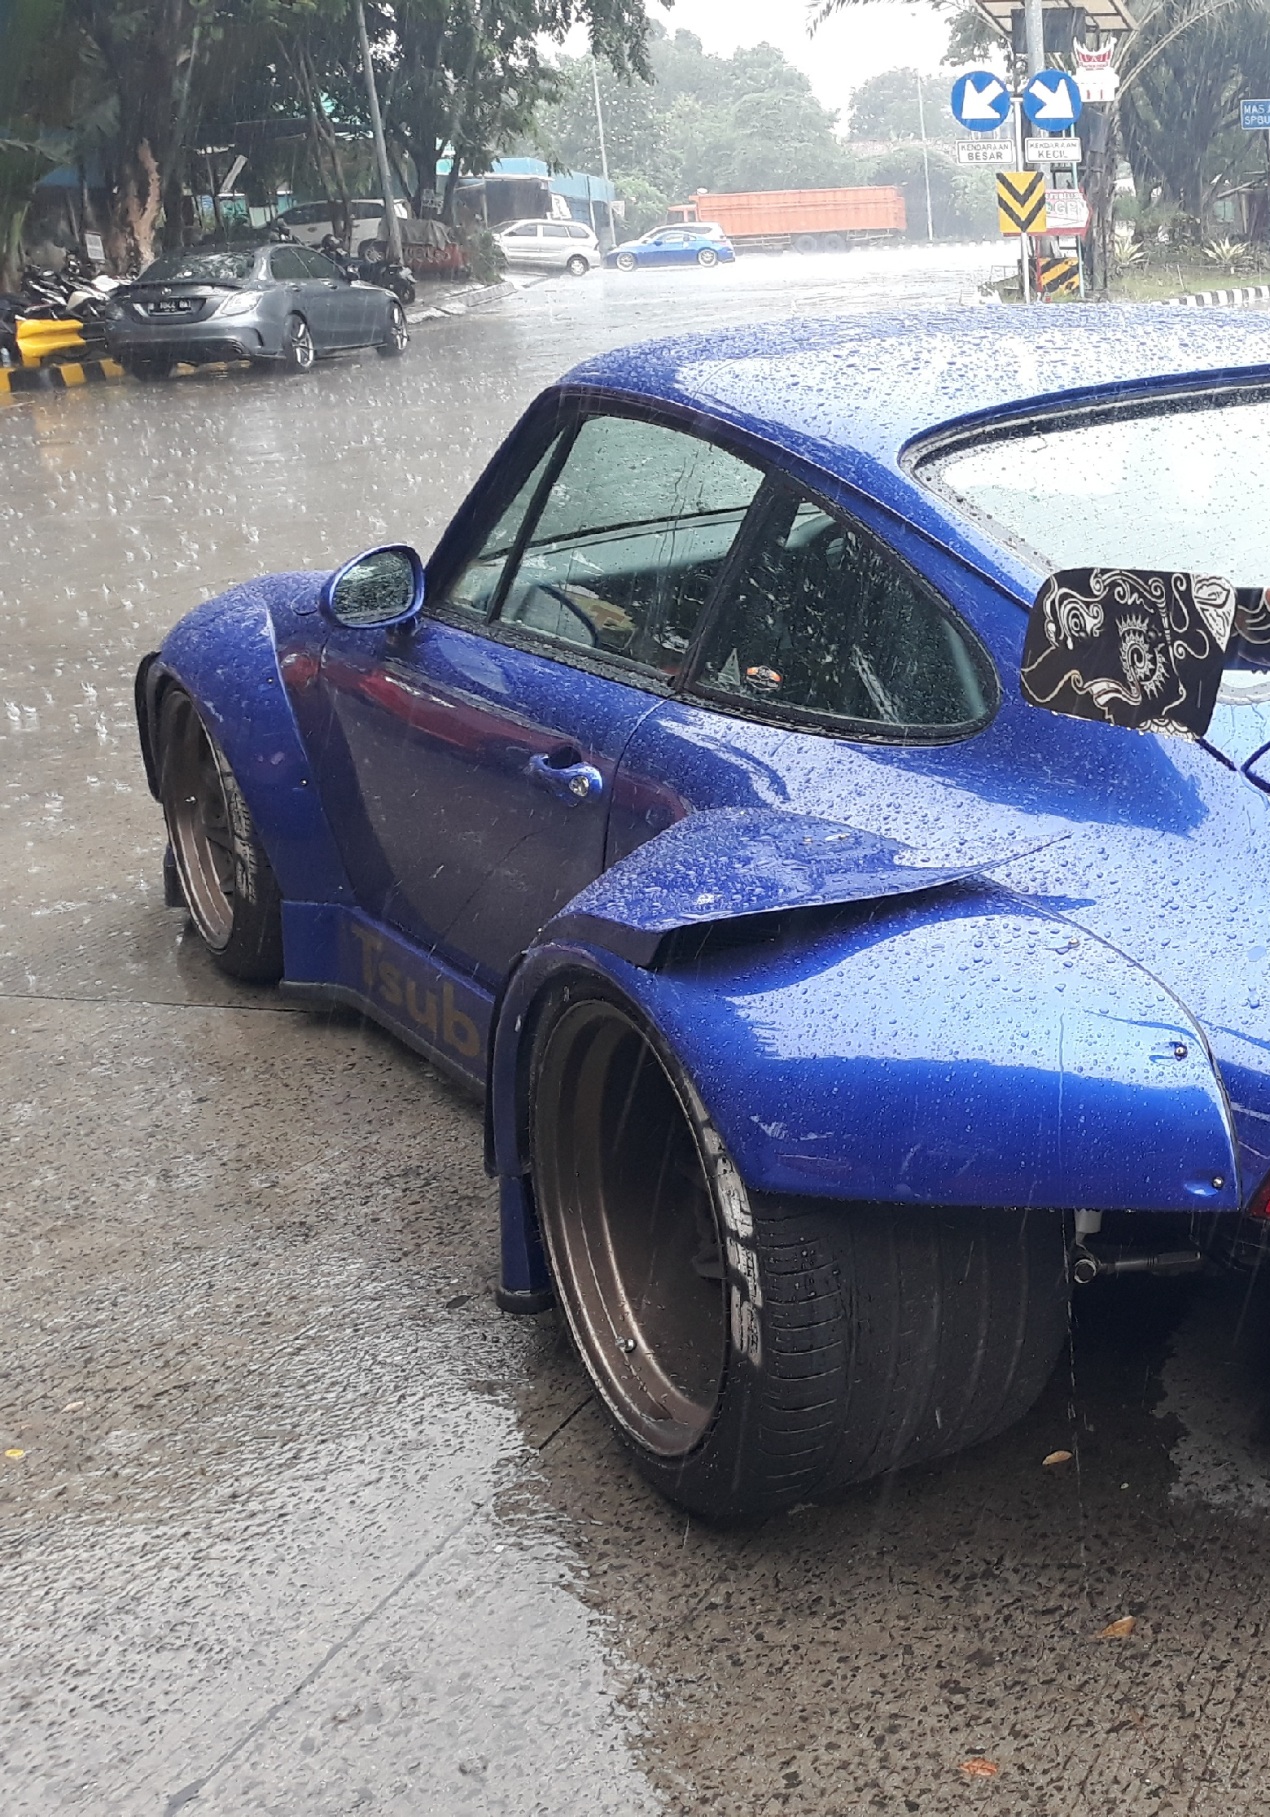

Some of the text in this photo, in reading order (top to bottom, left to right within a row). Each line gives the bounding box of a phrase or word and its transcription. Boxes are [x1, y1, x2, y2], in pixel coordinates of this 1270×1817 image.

[1244, 115, 1270, 125] SPBU
[967, 151, 1003, 161] BESAR
[1037, 150, 1069, 159] KECIL
